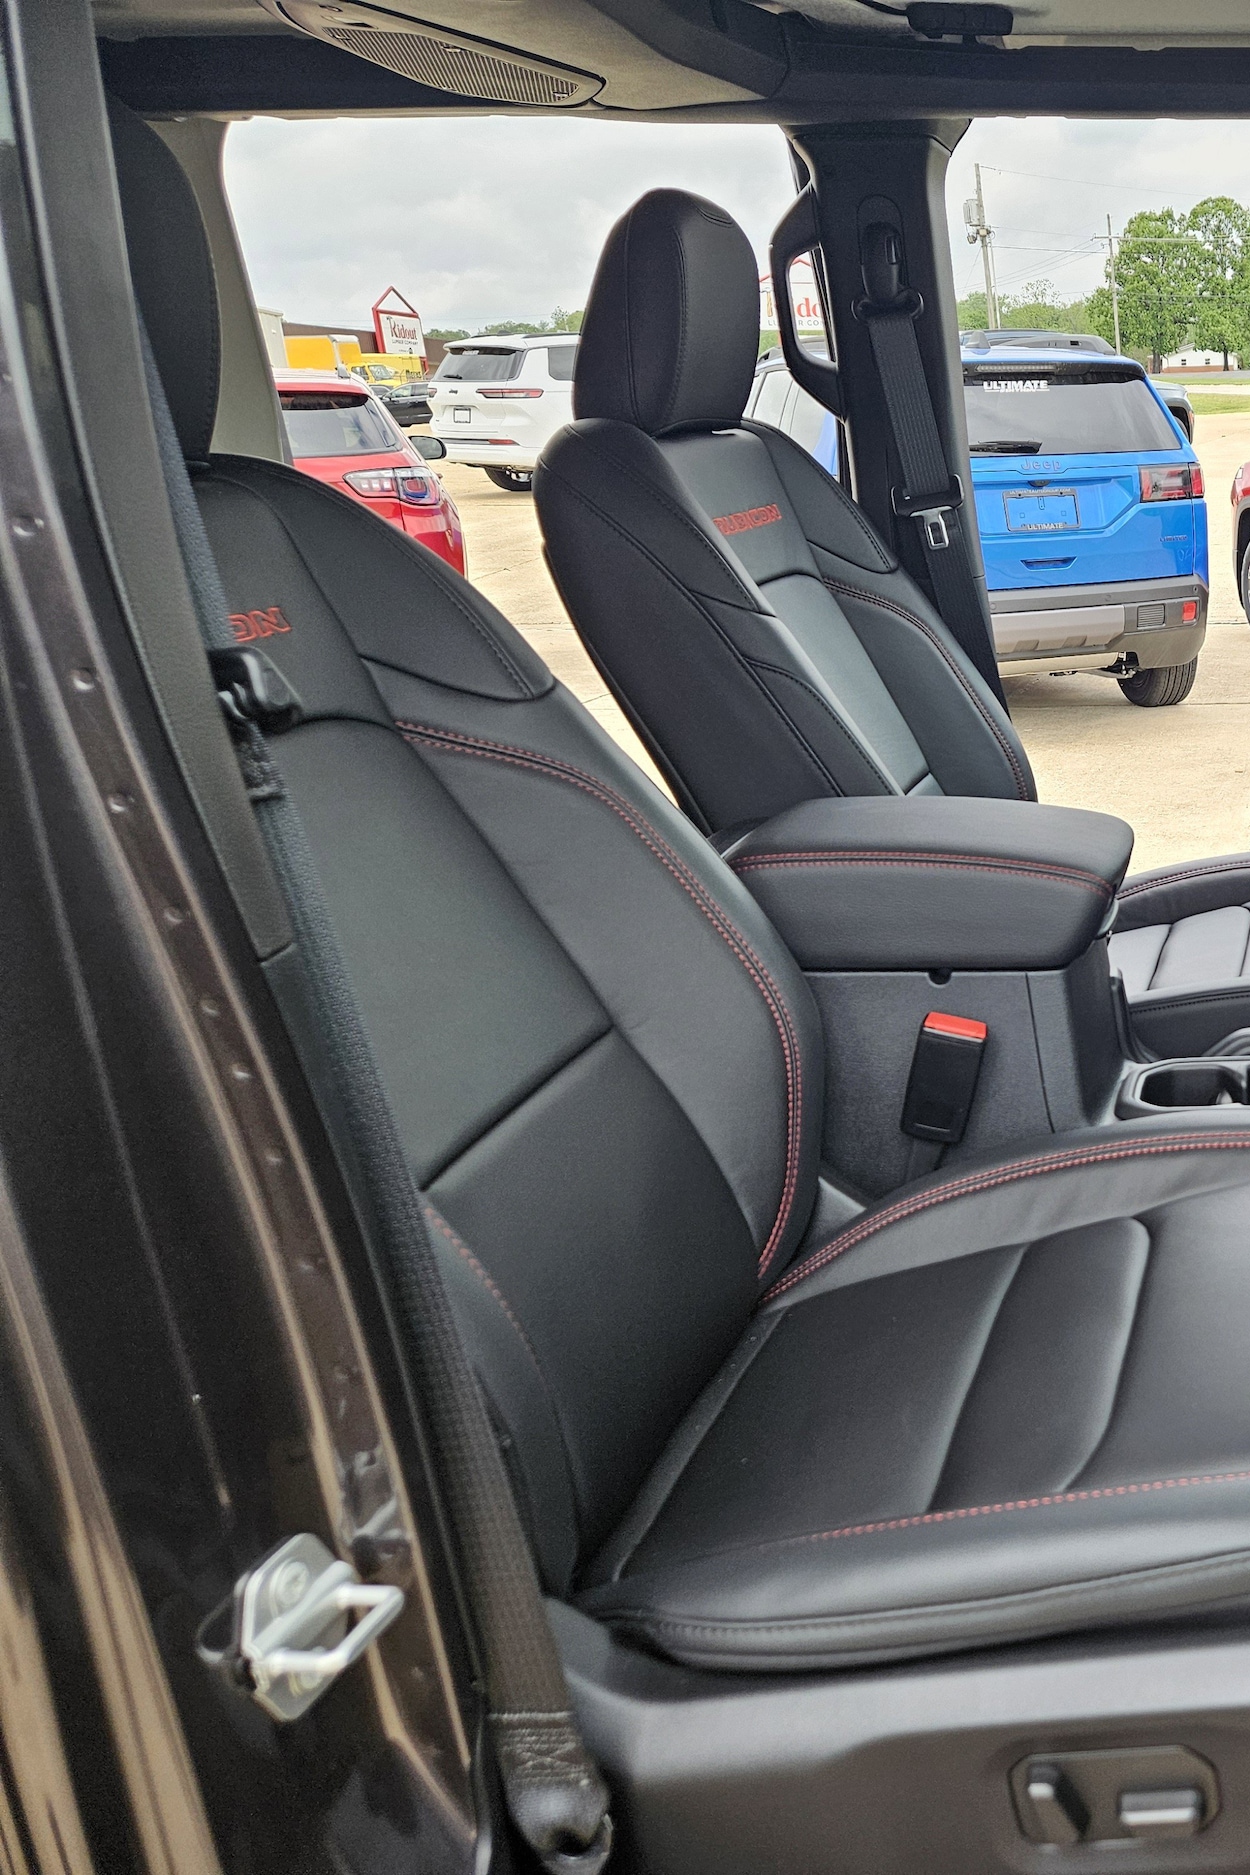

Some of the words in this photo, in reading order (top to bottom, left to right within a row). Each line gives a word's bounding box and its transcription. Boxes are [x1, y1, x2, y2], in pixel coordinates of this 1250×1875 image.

[386, 316, 418, 340] Ridout
[983, 380, 1049, 391] ULTIMATE
[1021, 457, 1061, 472] Jeep
[1027, 522, 1064, 531] ULTIMATE
